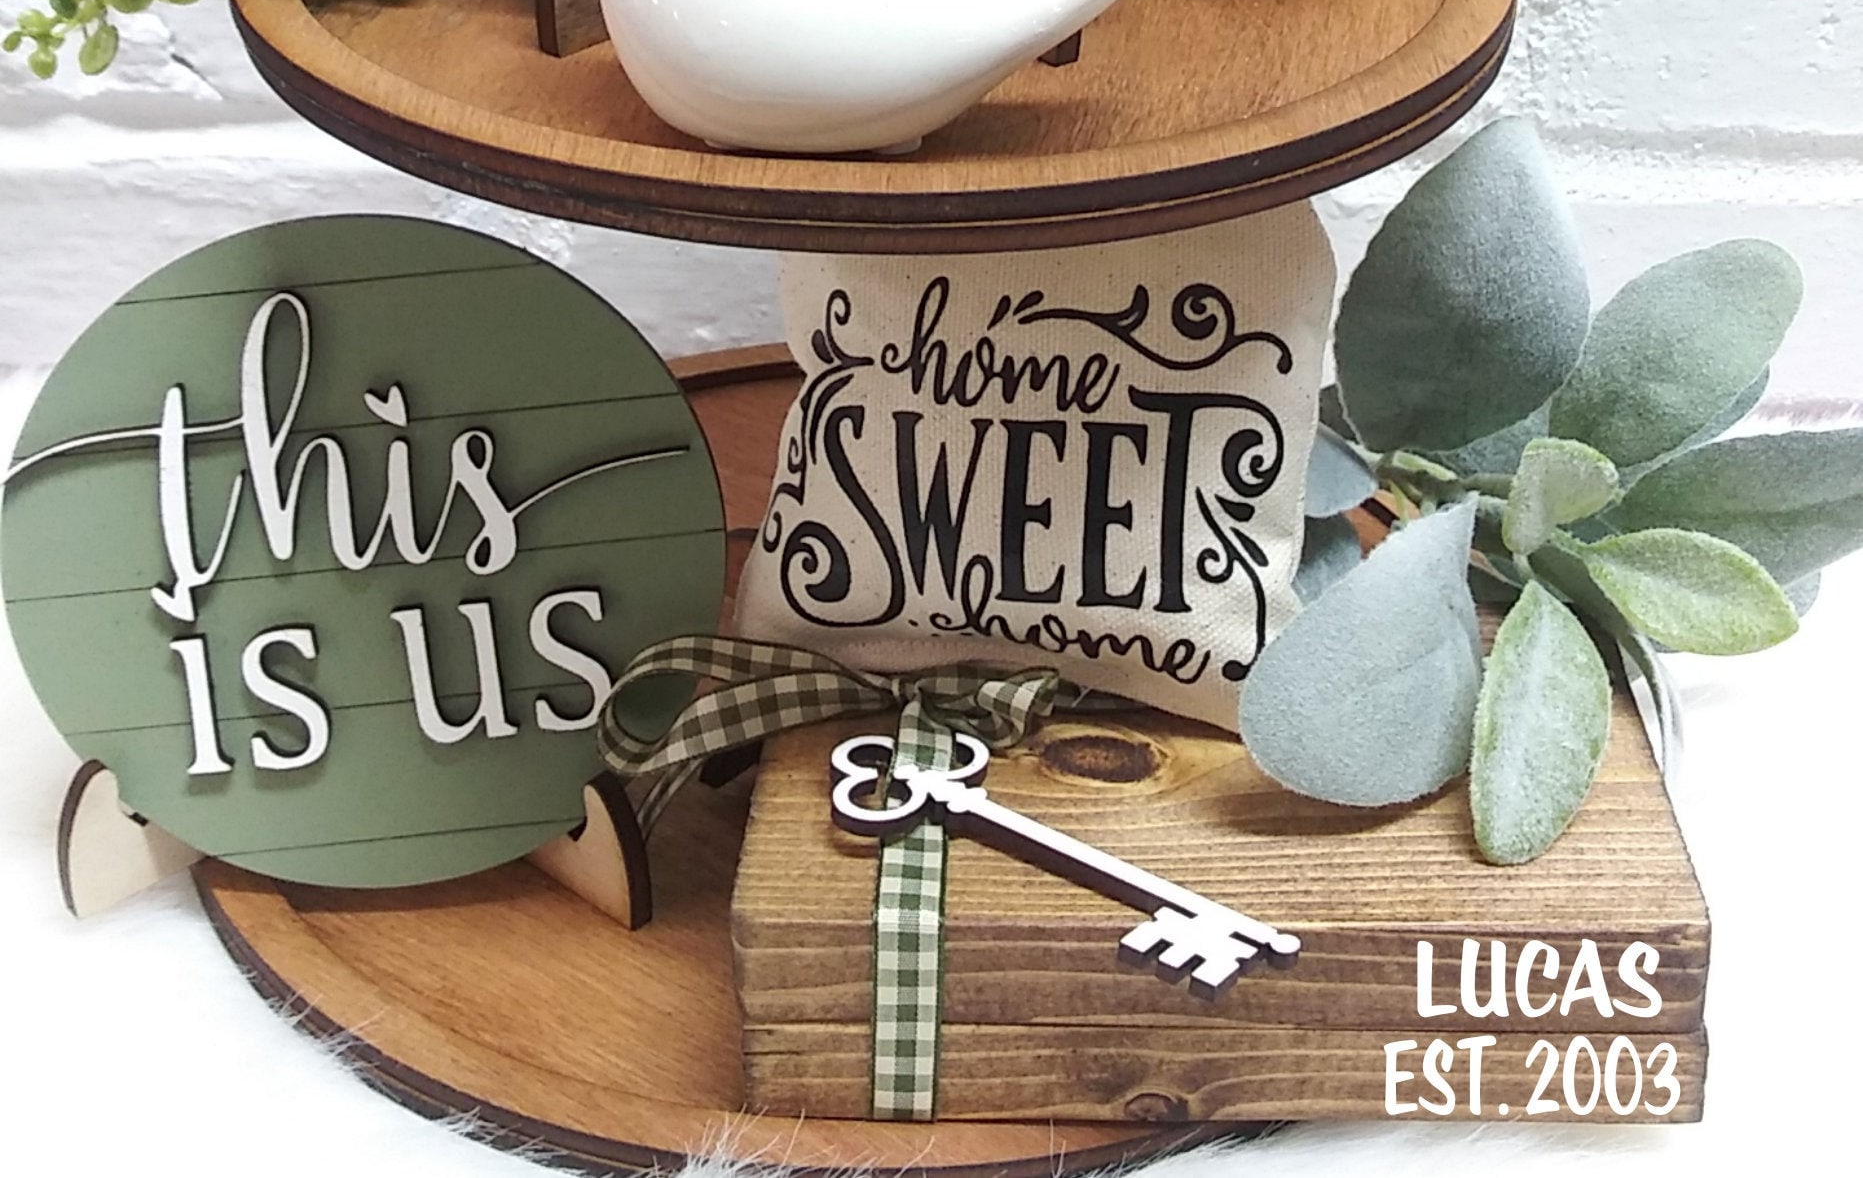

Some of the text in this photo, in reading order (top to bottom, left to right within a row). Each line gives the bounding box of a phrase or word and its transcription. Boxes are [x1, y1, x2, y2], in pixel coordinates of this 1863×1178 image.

[881, 277, 1120, 413] home
[780, 385, 1284, 627] SWEET
[151, 585, 612, 775] is us
[931, 555, 1211, 684] home
